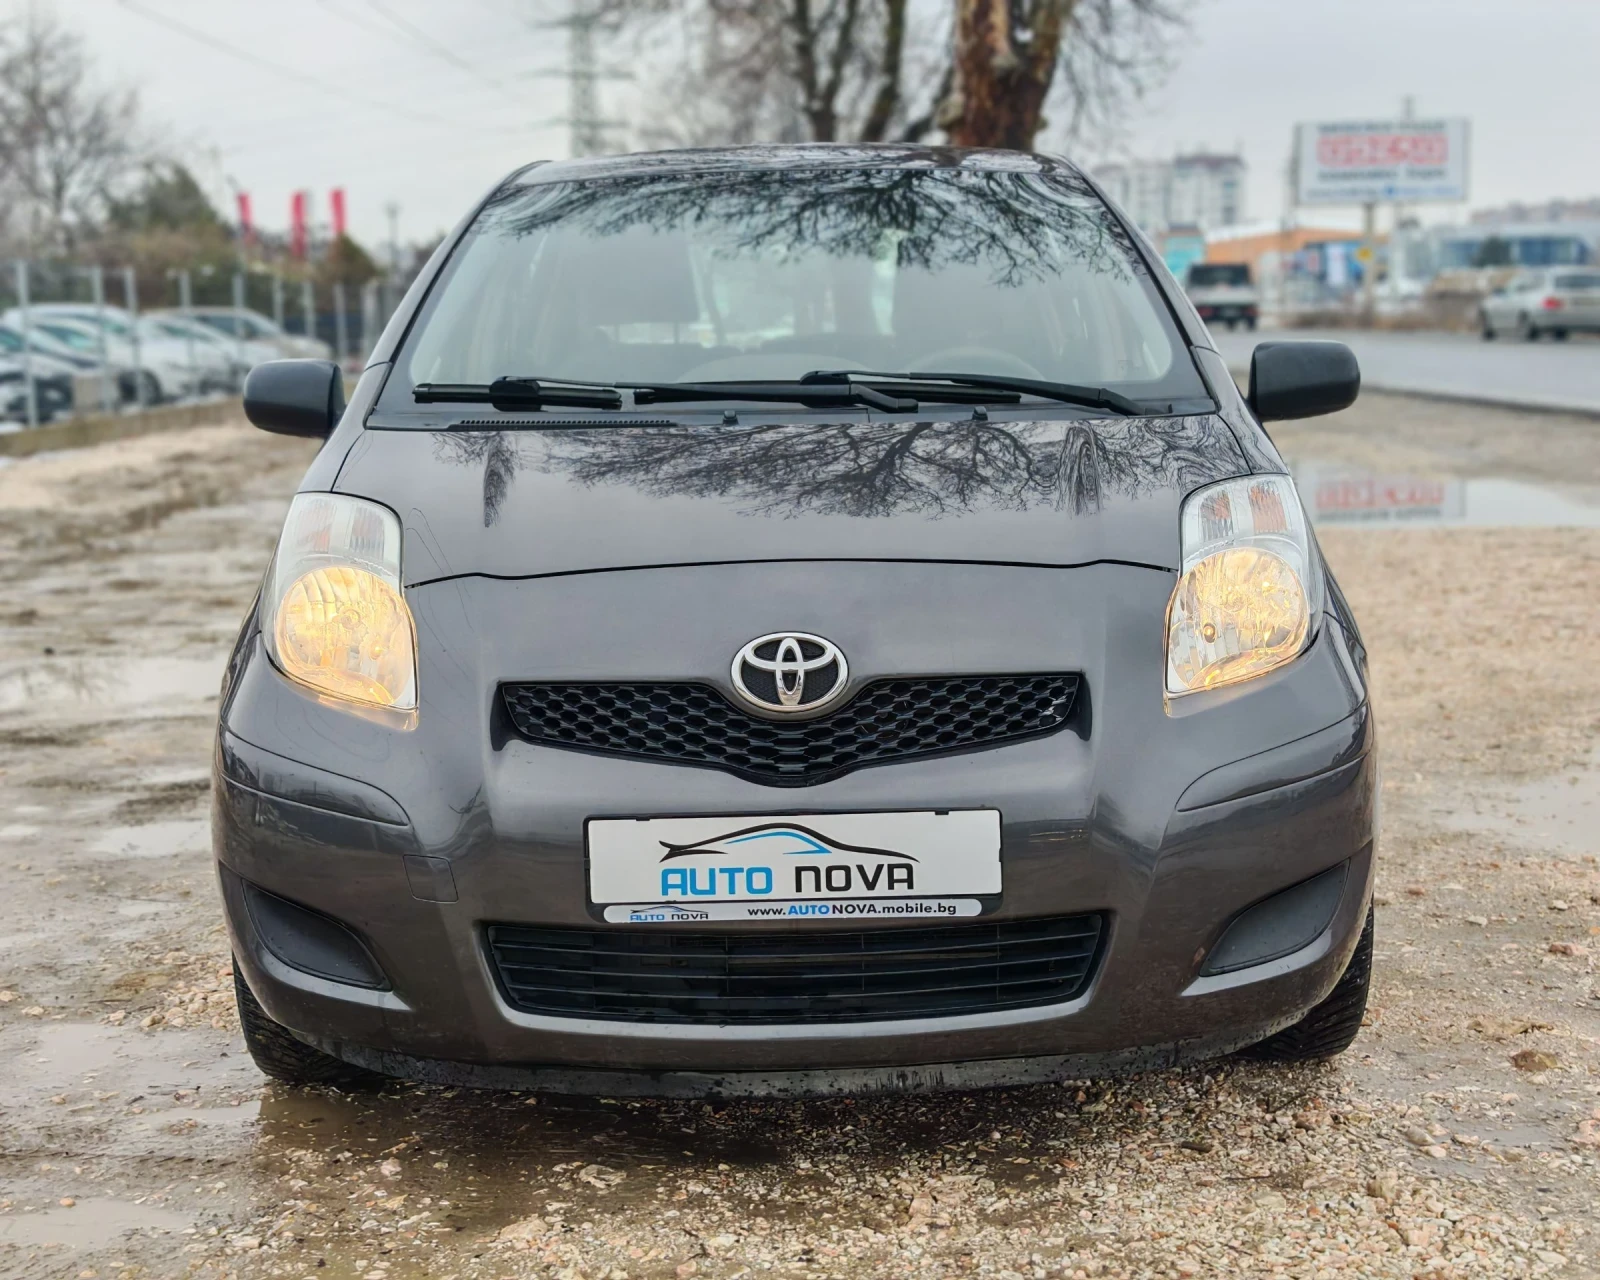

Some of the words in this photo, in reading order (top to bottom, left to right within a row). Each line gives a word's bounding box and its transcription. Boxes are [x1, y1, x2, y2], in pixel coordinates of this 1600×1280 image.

[661, 866, 773, 896] AUTO
[795, 863, 914, 893] NOVA
[747, 903, 957, 916] www.AUTONOVA.mobile.bg
